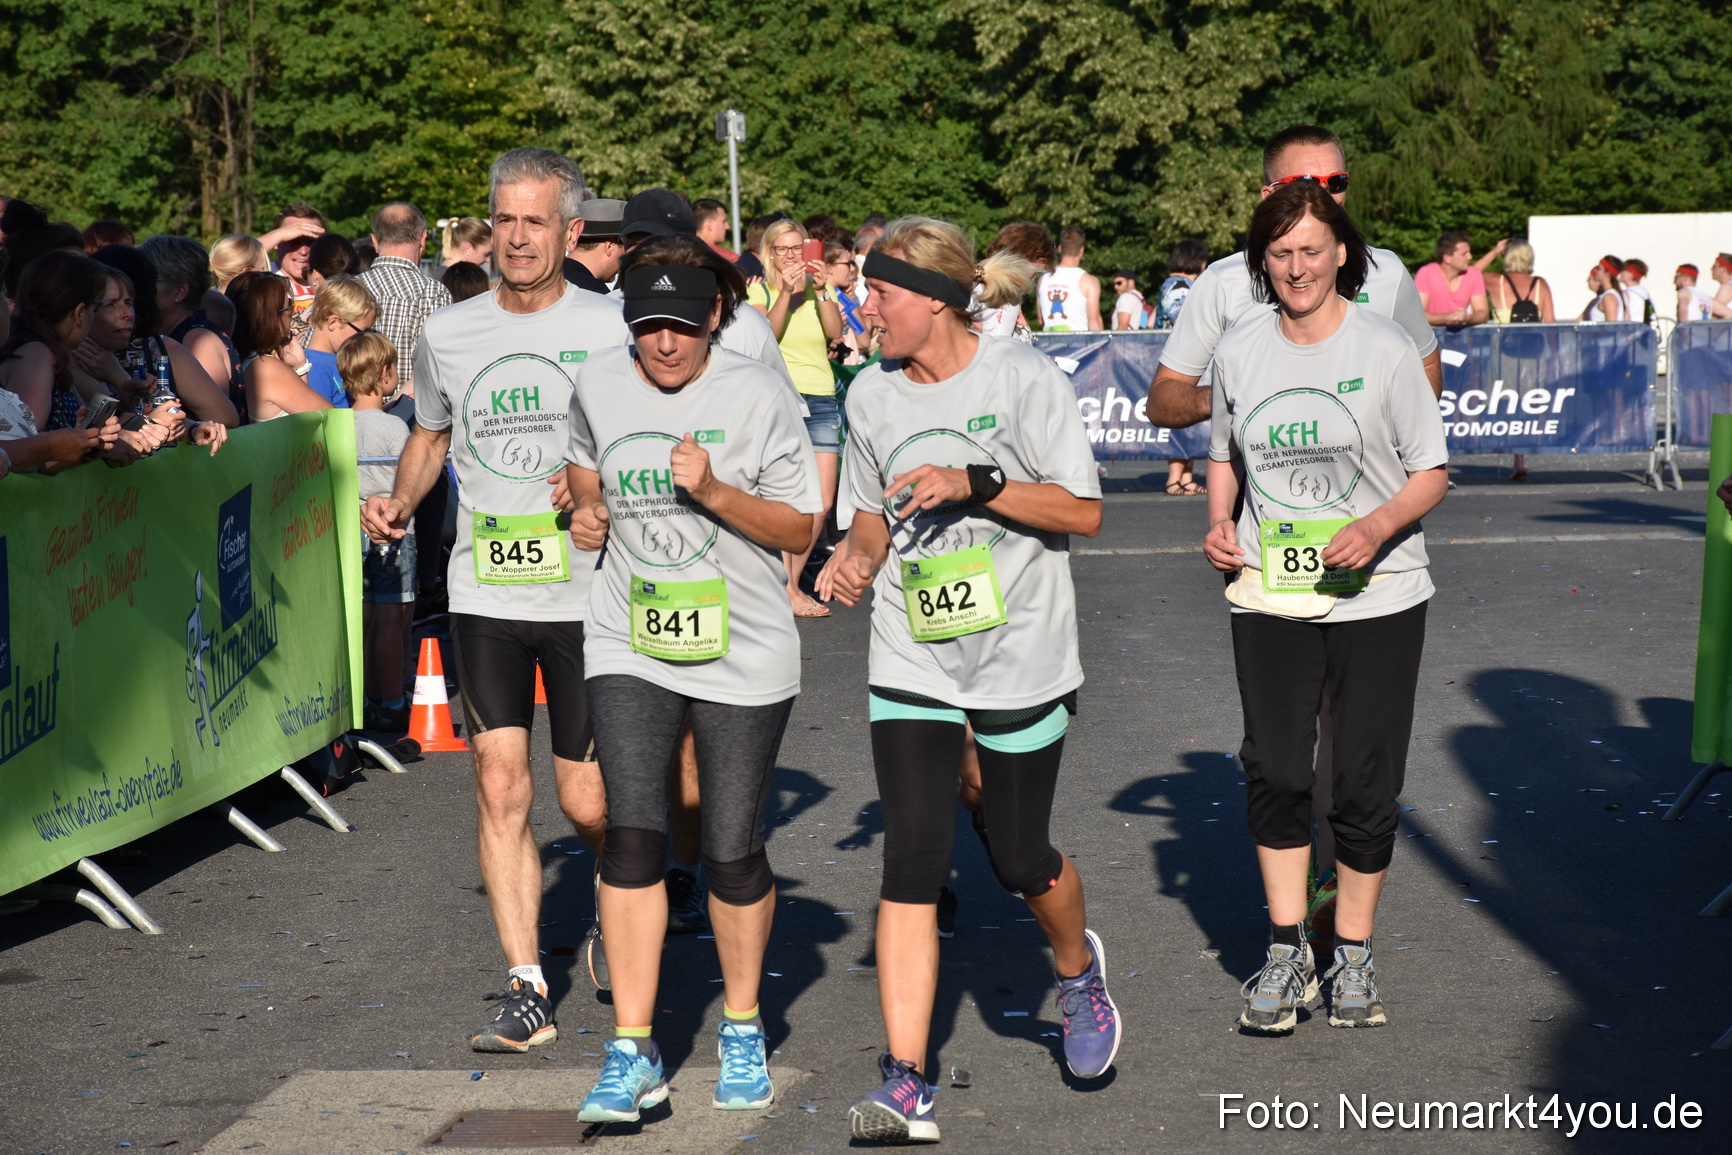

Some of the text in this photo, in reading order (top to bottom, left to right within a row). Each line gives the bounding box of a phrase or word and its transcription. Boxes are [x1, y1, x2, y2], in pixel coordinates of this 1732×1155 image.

[1077, 387, 1149, 423] che
[1438, 379, 1576, 417] scher
[473, 408, 488, 418] DAS
[483, 413, 568, 427] DER NEPHROLOGISCH
[474, 424, 556, 439] GESAMTVERSORGER.
[1087, 428, 1171, 443] MOBILE
[1443, 419, 1559, 437] TOMOBILE
[1250, 443, 1267, 452] DAS
[1263, 445, 1354, 460] DER NEPHROLOGISCHE
[1255, 456, 1338, 473] GESAMTVERSORGER.
[607, 488, 619, 498] DAS
[96, 486, 140, 539] Firmen
[616, 500, 630, 509] DER
[224, 531, 247, 562] Fischer
[489, 540, 544, 565] 845
[502, 566, 537, 574] Wopperer
[540, 563, 560, 571] Josef
[918, 581, 976, 617] 842
[646, 608, 699, 637] 841
[926, 610, 977, 626] Krebs Anschi
[210, 572, 279, 701] firmenlauf
[637, 632, 718, 647] Weixelbaum Angelika
[0, 641, 59, 760] nlauf
